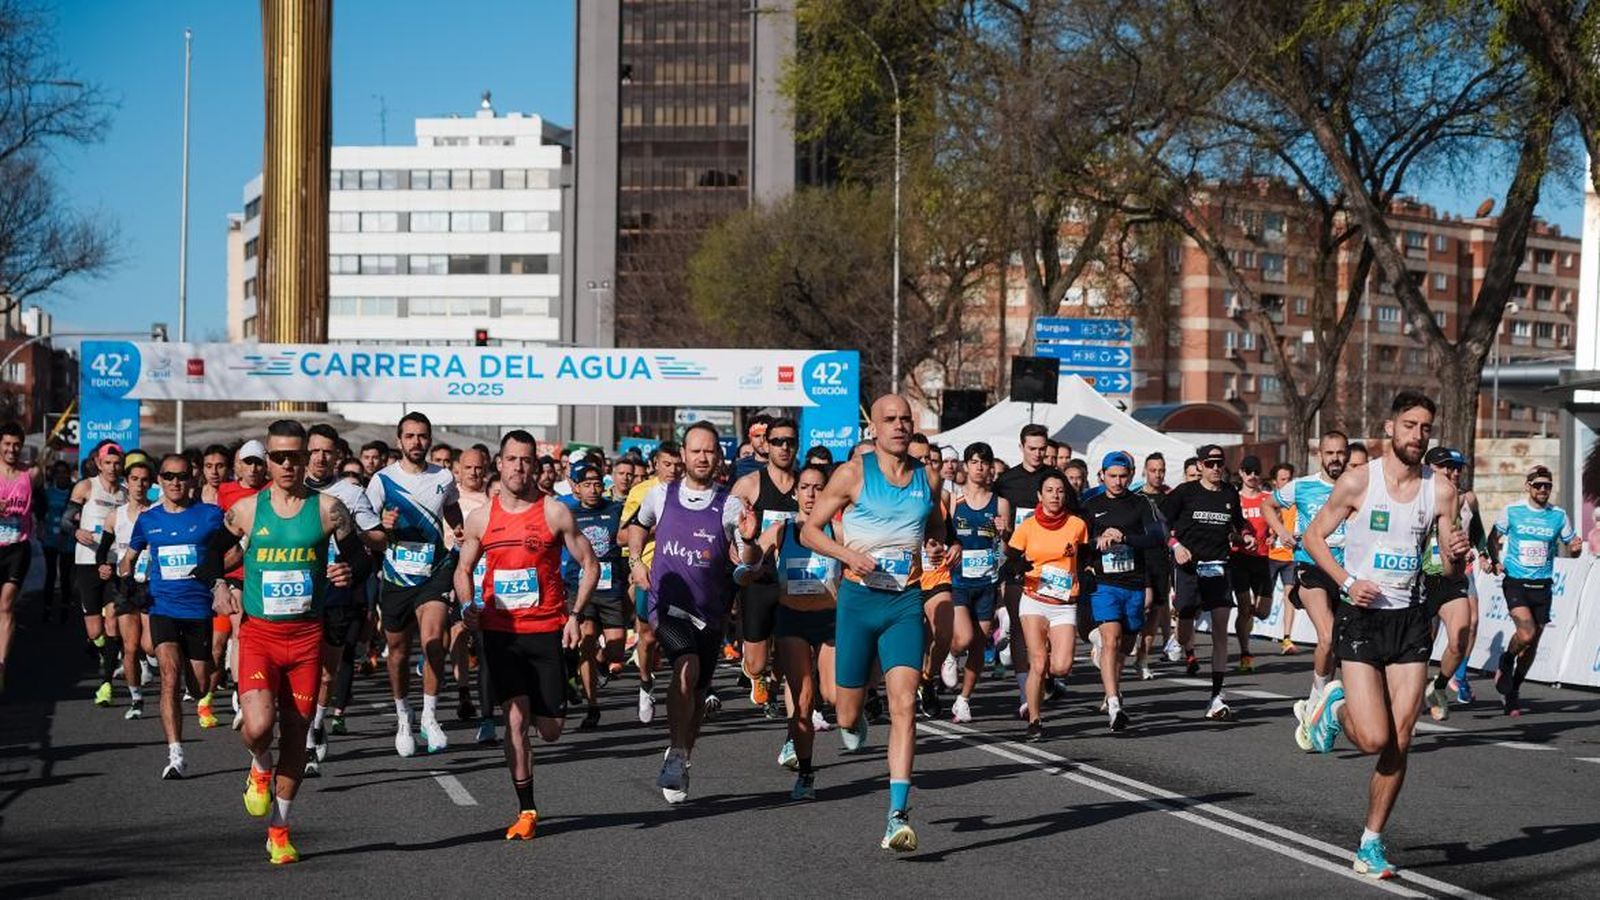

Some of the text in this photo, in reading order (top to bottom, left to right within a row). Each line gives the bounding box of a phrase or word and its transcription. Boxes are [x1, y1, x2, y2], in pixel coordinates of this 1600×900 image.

[1036, 323, 1070, 334] Burgos
[91, 353, 130, 377] 42ª
[300, 352, 653, 380] CARRERA DEL AGUA
[812, 362, 849, 385] 42ª
[91, 378, 129, 388] EDICIÓN
[448, 382, 504, 396] 2025
[812, 385, 849, 396] EDICIÓN
[87, 421, 112, 430] Canal
[87, 431, 97, 439] de
[99, 431, 126, 440] Isabel
[810, 428, 835, 439] Canal
[810, 438, 821, 447] de
[822, 439, 848, 448] Isabel
[1516, 525, 1554, 537] 2025
[167, 555, 187, 567] 611
[256, 547, 317, 563] BIKILA
[404, 550, 427, 562] 910
[969, 557, 988, 567] 992
[271, 583, 305, 597] 309
[501, 581, 529, 593] 734
